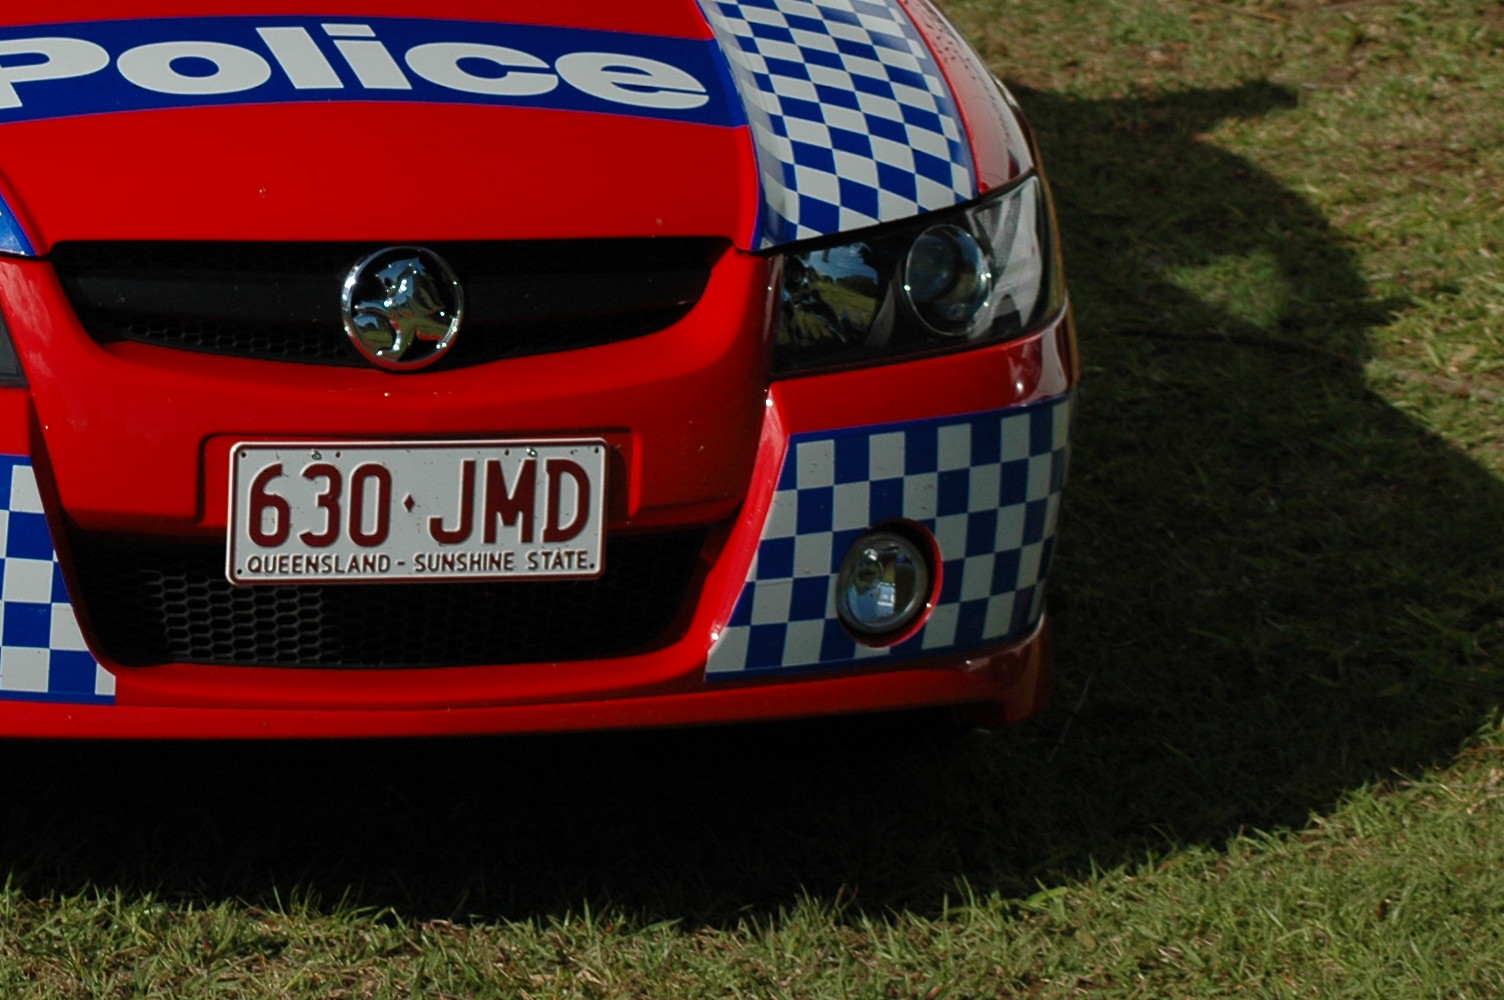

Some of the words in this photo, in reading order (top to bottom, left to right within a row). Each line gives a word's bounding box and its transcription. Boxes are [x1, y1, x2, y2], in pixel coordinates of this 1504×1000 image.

[246, 553, 392, 575] QUEENSLAND
[414, 551, 515, 573] SUNSHINE
[527, 549, 590, 570] STATE
